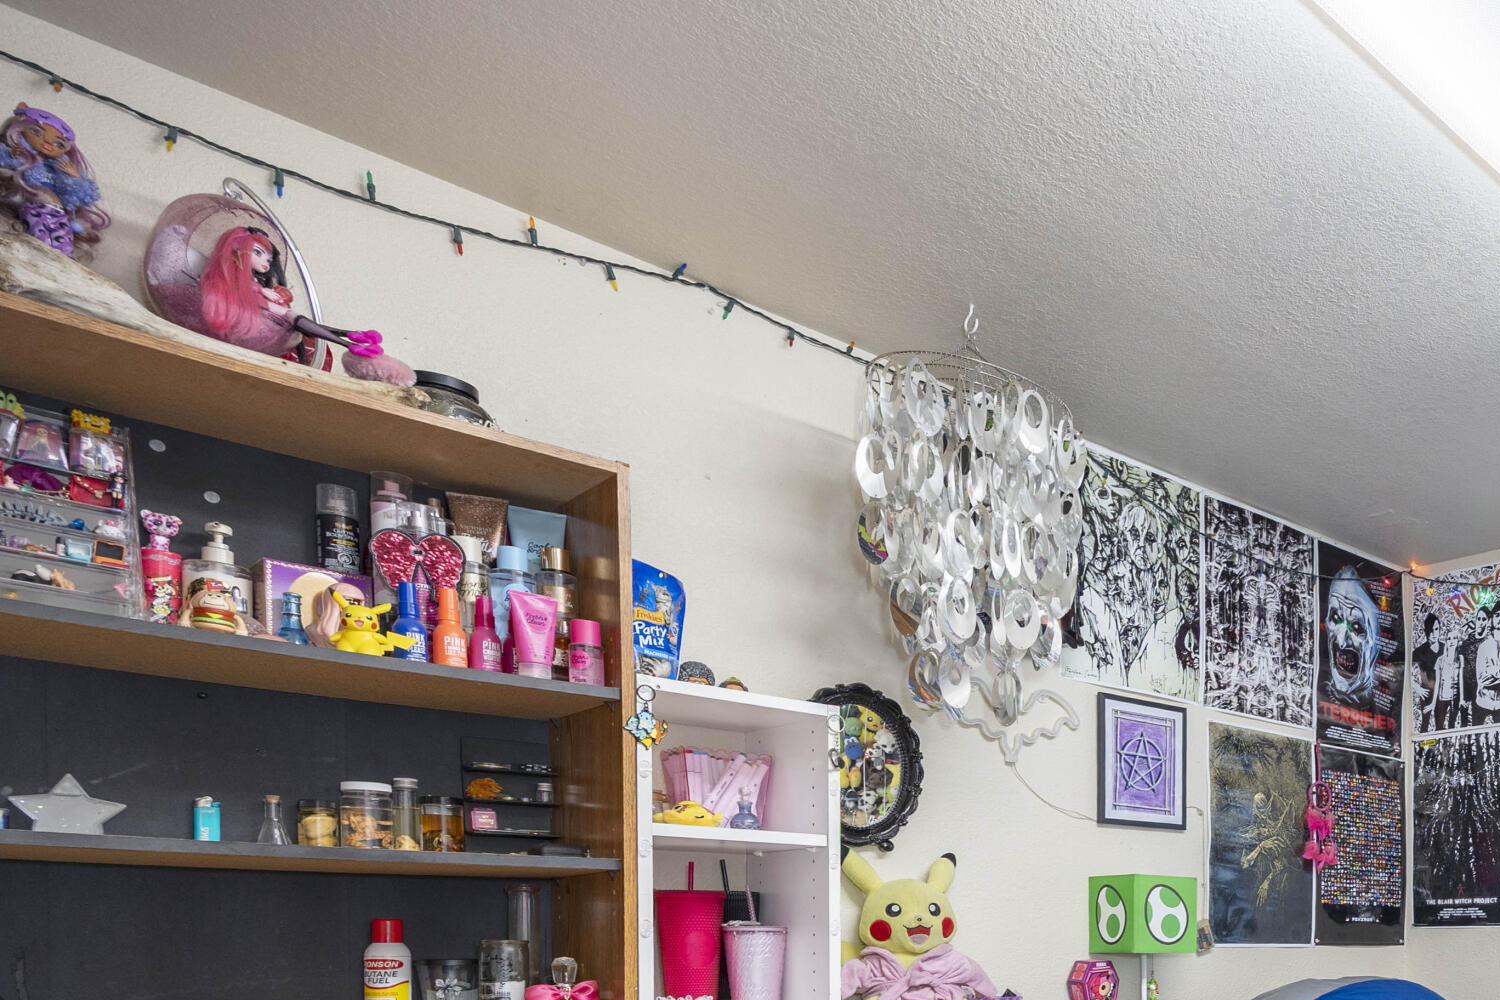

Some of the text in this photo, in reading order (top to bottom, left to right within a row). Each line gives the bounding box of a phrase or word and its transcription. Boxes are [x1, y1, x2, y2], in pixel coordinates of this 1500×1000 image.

[636, 610, 663, 623] Friskies
[633, 621, 667, 637] Party
[444, 636, 467, 647] PINK
[482, 639, 500, 650] PINK
[639, 635, 665, 648] Mix
[1320, 701, 1398, 731] TERRIFIER
